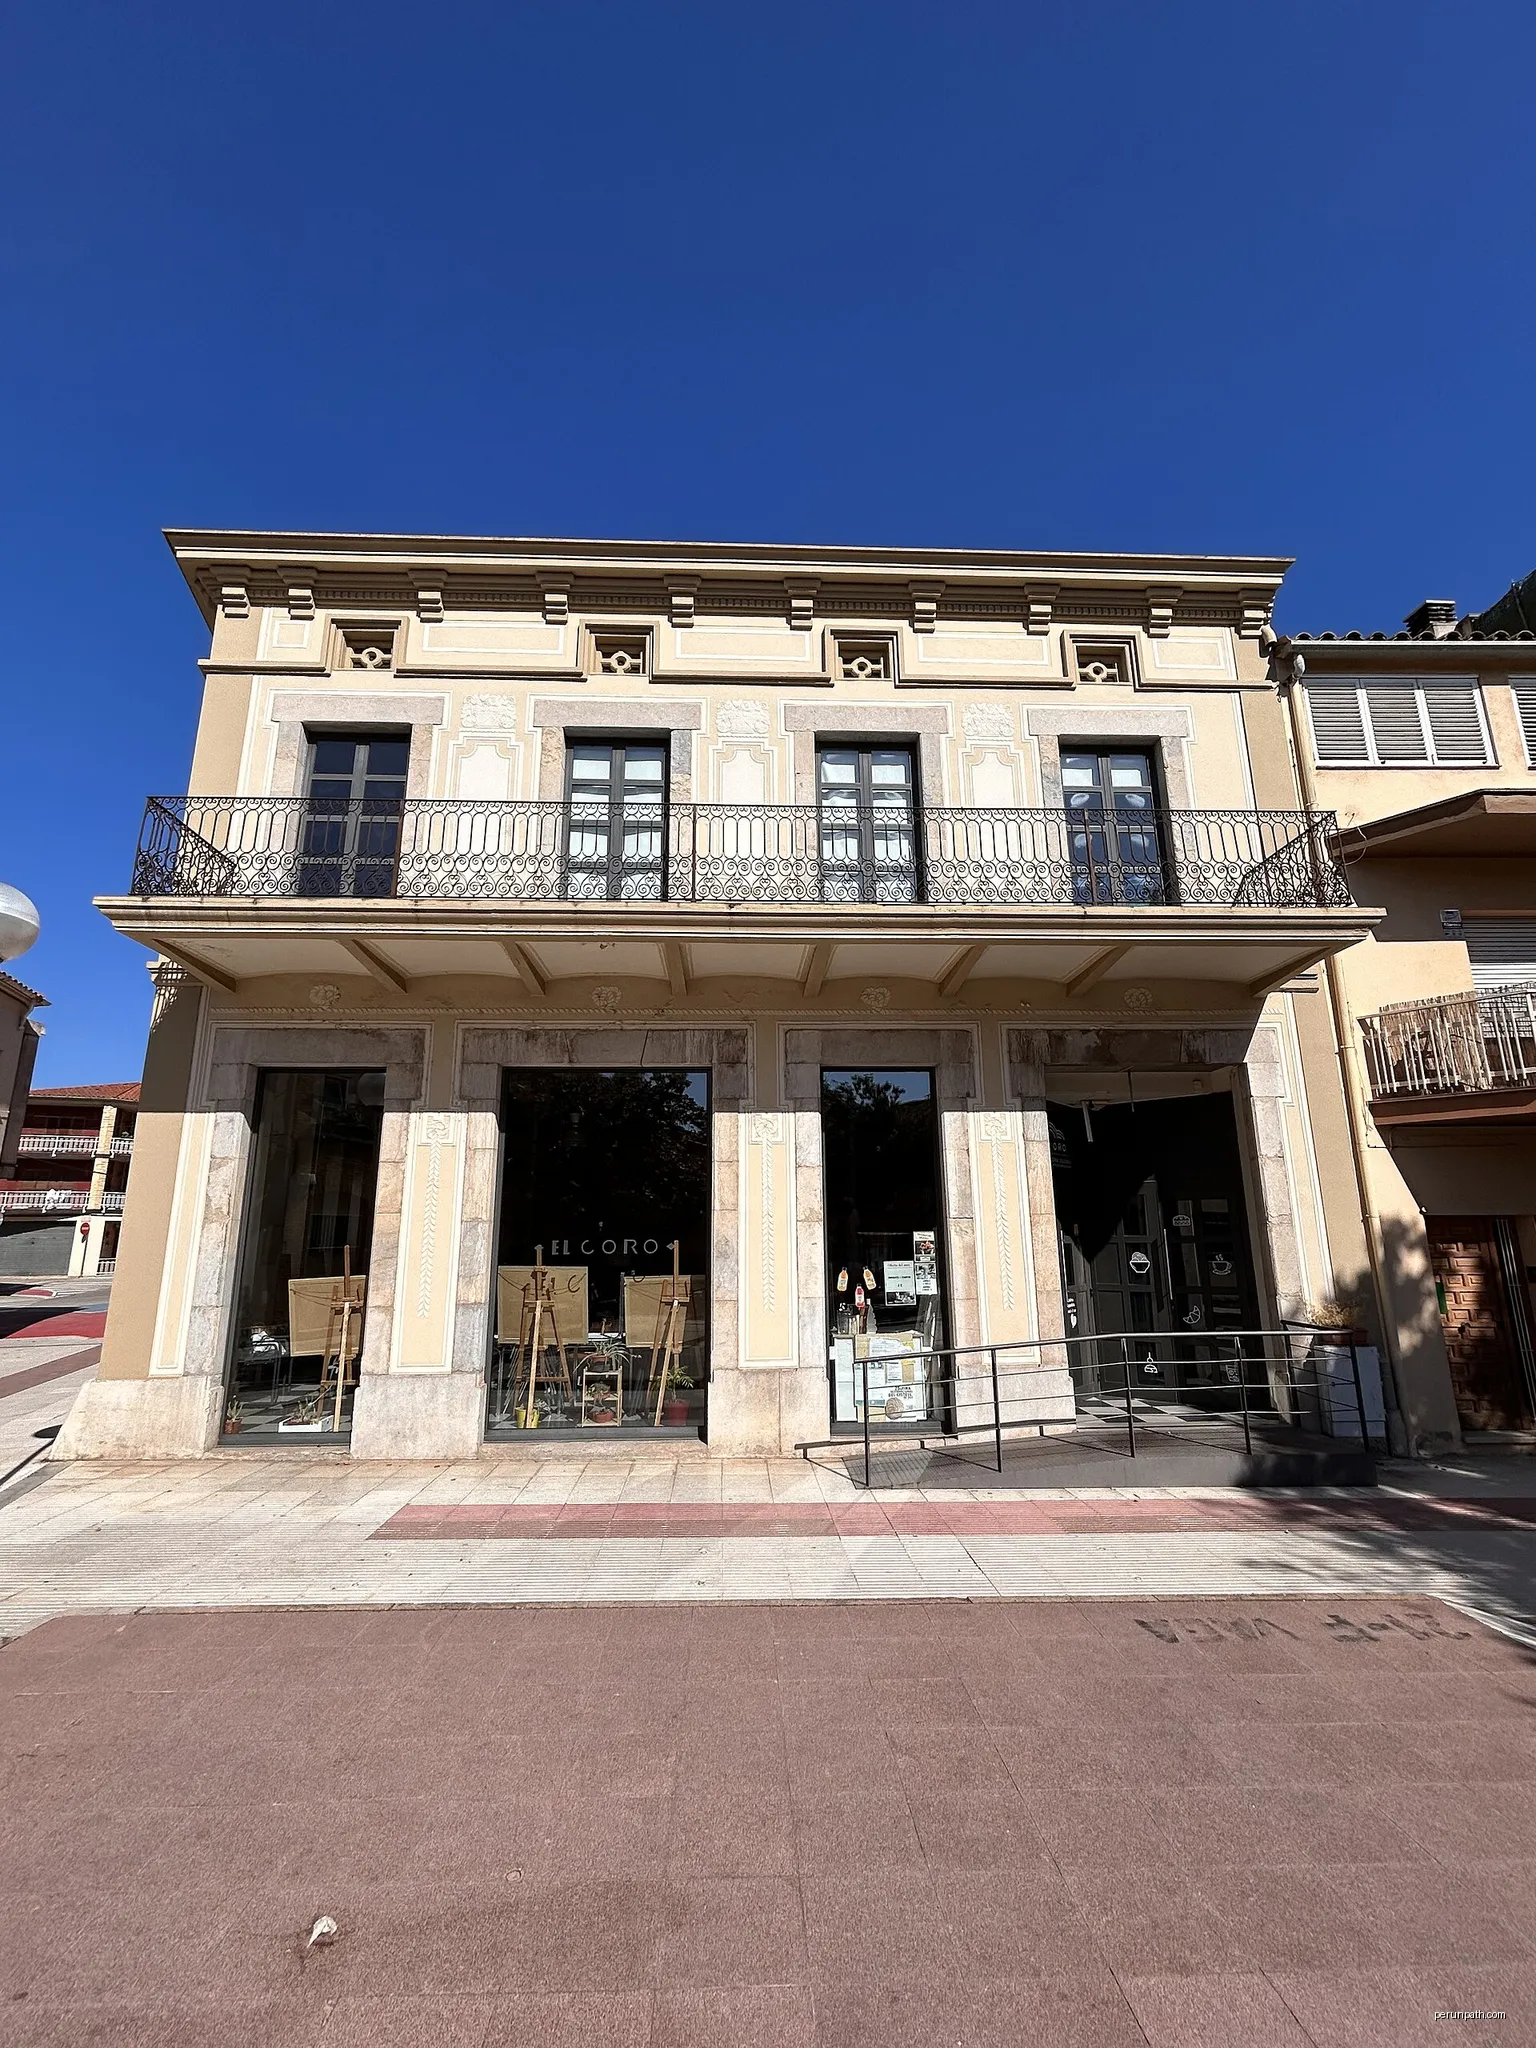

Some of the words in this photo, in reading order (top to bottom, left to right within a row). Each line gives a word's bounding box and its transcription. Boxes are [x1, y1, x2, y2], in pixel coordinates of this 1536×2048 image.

[1052, 1142, 1067, 1152] ORO
[551, 1240, 570, 1255] EL
[581, 1238, 658, 1254] CORO
